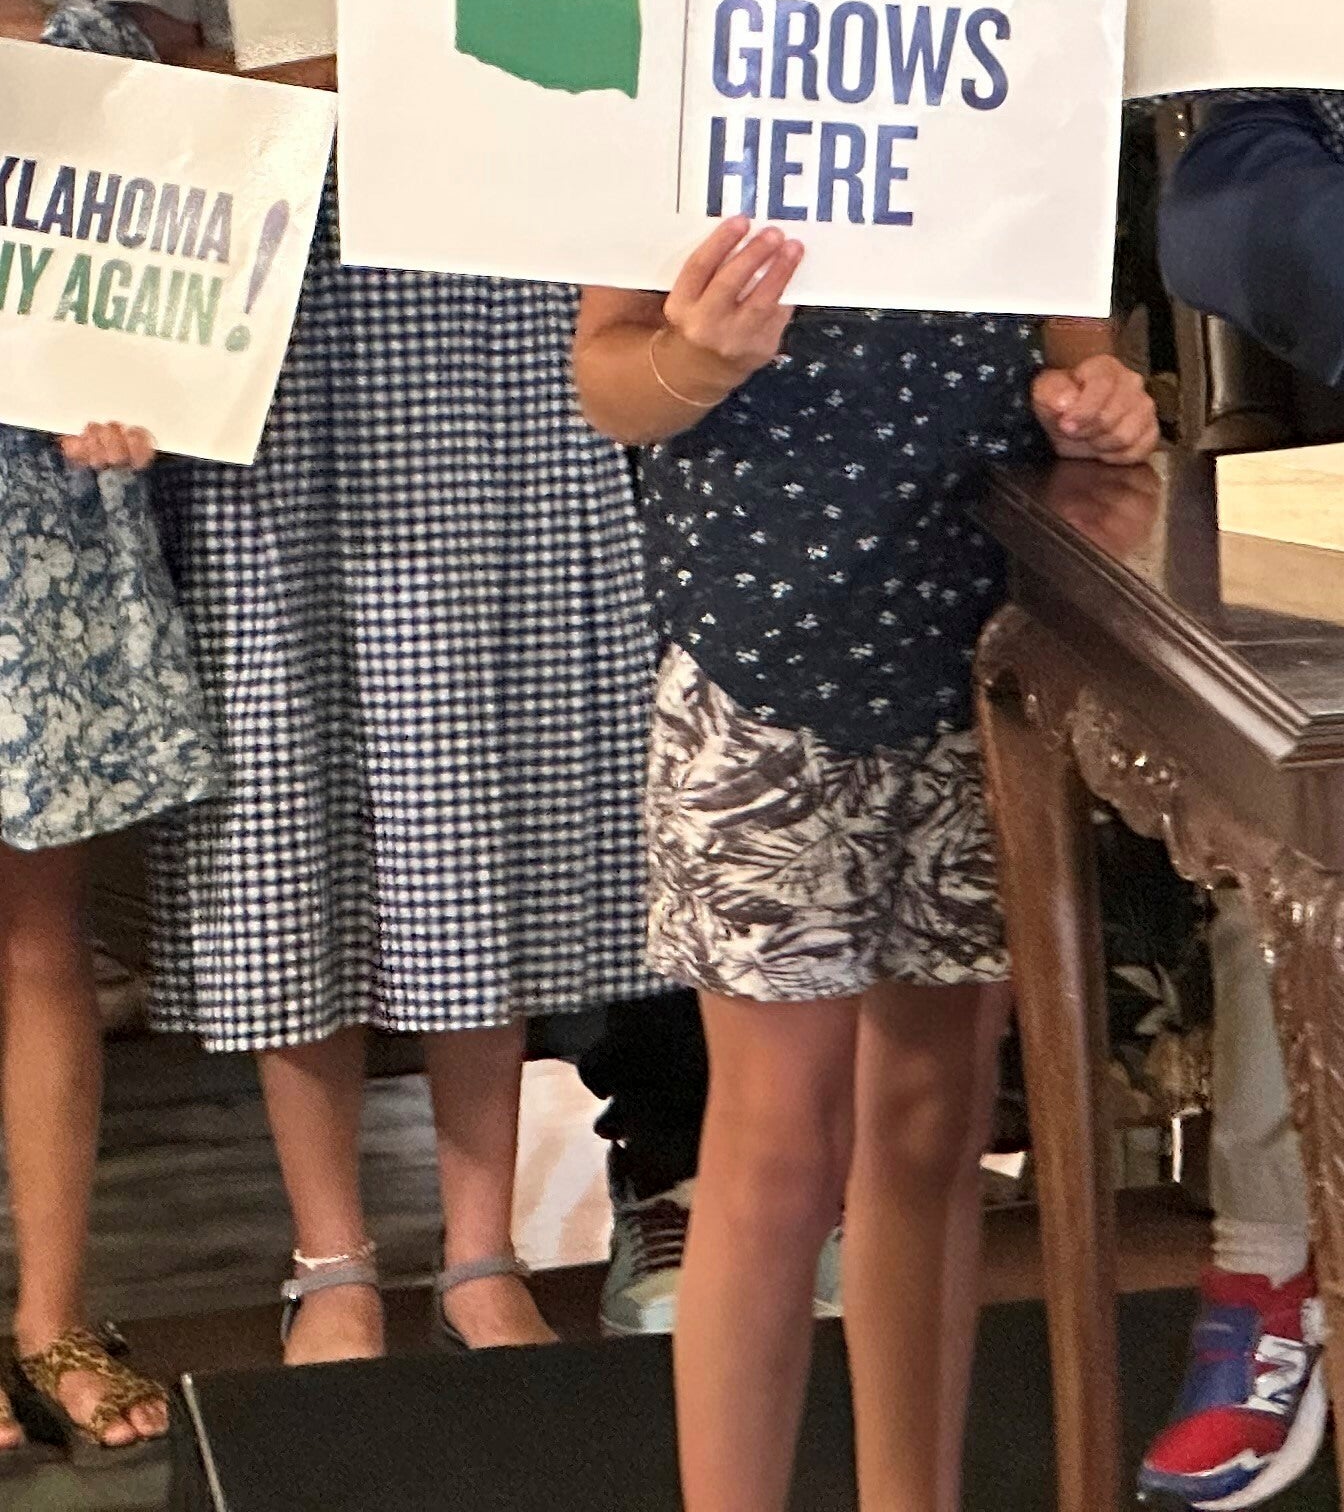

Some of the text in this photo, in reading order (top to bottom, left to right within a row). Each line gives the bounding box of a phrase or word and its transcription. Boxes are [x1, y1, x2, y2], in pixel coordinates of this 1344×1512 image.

[0, 156, 234, 265] KLAHOMA
[705, 116, 919, 226] HERE
[54, 252, 222, 347] AGAIN
